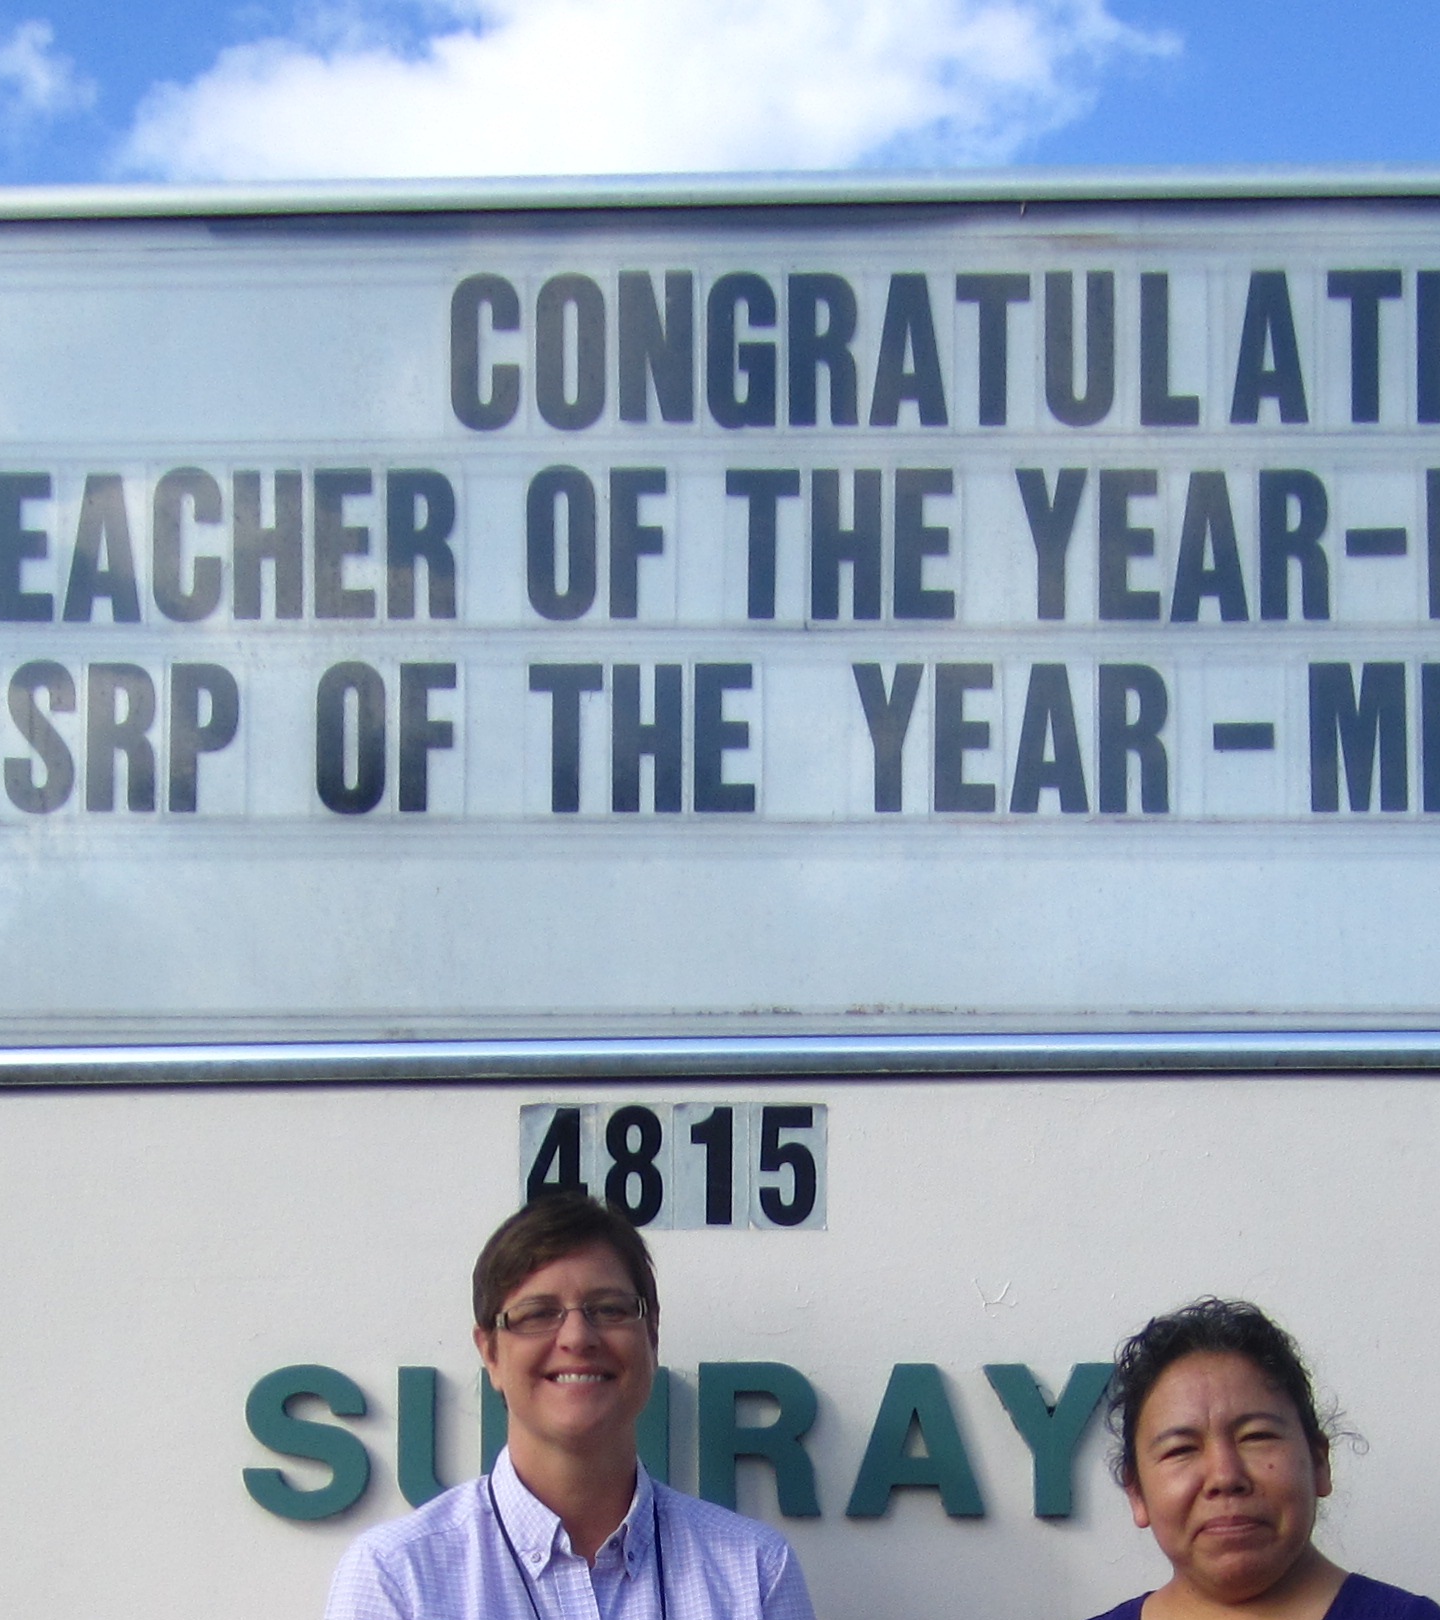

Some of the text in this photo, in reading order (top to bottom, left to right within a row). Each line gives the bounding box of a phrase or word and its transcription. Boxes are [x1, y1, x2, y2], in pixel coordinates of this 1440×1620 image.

[526, 464, 667, 621] OF
[726, 467, 956, 621] THE
[3, 660, 240, 814] SRP
[316, 661, 457, 815] OF
[529, 662, 756, 813] THE
[526, 1105, 817, 1227] 4815
[243, 1361, 1111, 1522] SURAY
